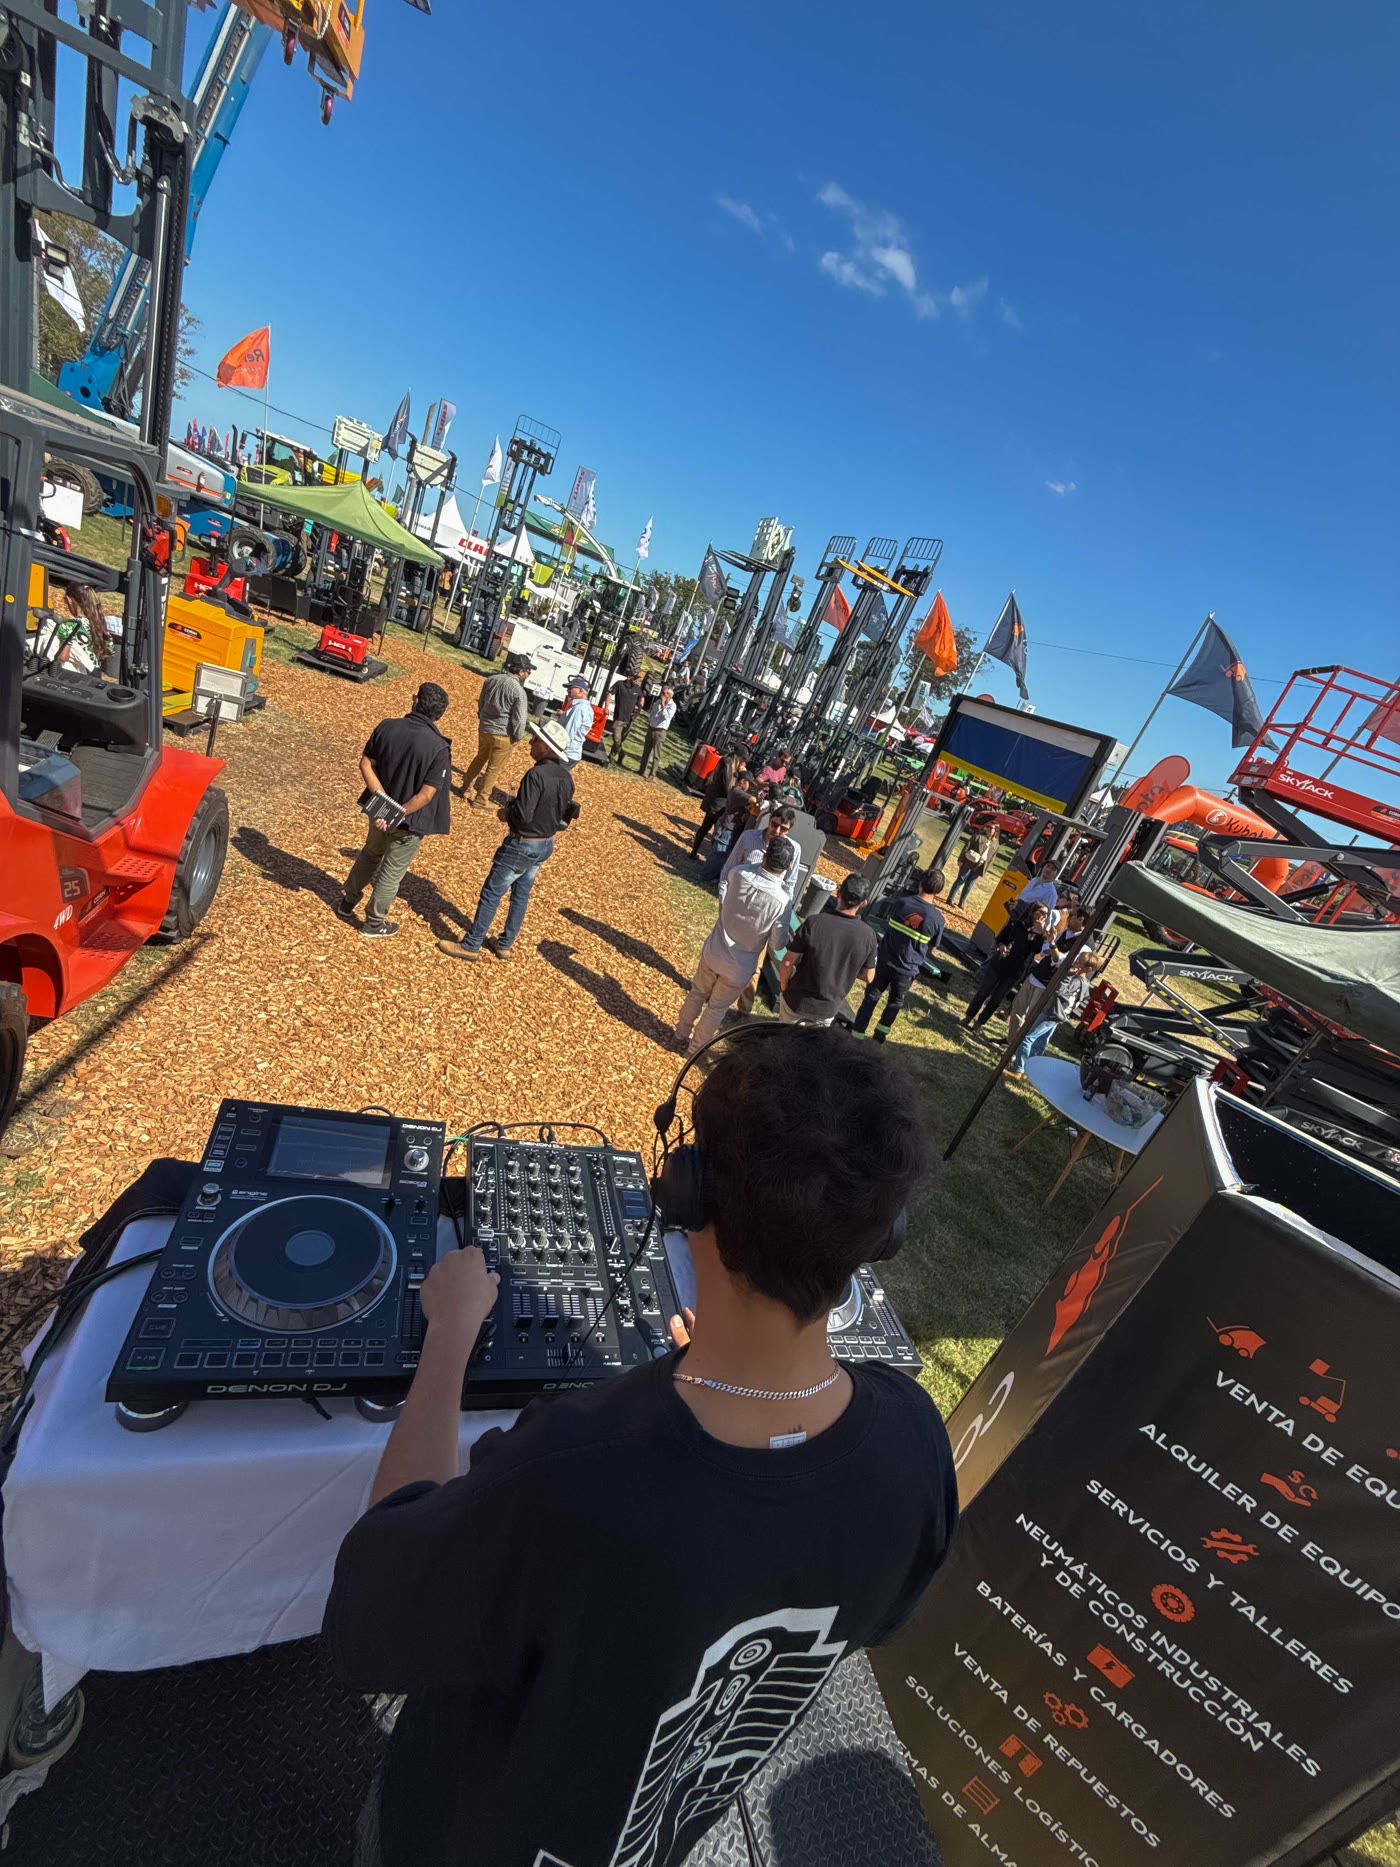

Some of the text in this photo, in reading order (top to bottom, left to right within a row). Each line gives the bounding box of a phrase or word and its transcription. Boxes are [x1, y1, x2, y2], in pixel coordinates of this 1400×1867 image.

[1278, 773, 1335, 799] SKYJACK
[64, 880, 80, 898] 25
[1178, 969, 1235, 982] SKYJACK
[402, 1123, 431, 1131] DENON
[518, 1140, 551, 1148] DENON
[1300, 1120, 1364, 1150] SKYJACK
[206, 1382, 348, 1394] DENON DJ
[1215, 1369, 1296, 1438] VENTA
[1301, 1432, 1345, 1467] DE
[1139, 1423, 1400, 1620] ALQUILER DE EQUIPO
[1085, 1479, 1355, 1695] SERVICIOS Y TALLERES
[1015, 1512, 1322, 1778] NEUMÁTICOS INDUSTRIALES
[1039, 1552, 1264, 1753] Y DE CONSTRUCCIÓN
[904, 1674, 1013, 1785] SOLUCIONES
[976, 1580, 1237, 1819] BATERÍAS Y CARGADORES
[953, 1642, 1161, 1848] VENTA DE REPUESTOS
[941, 1791, 967, 1819] DE
